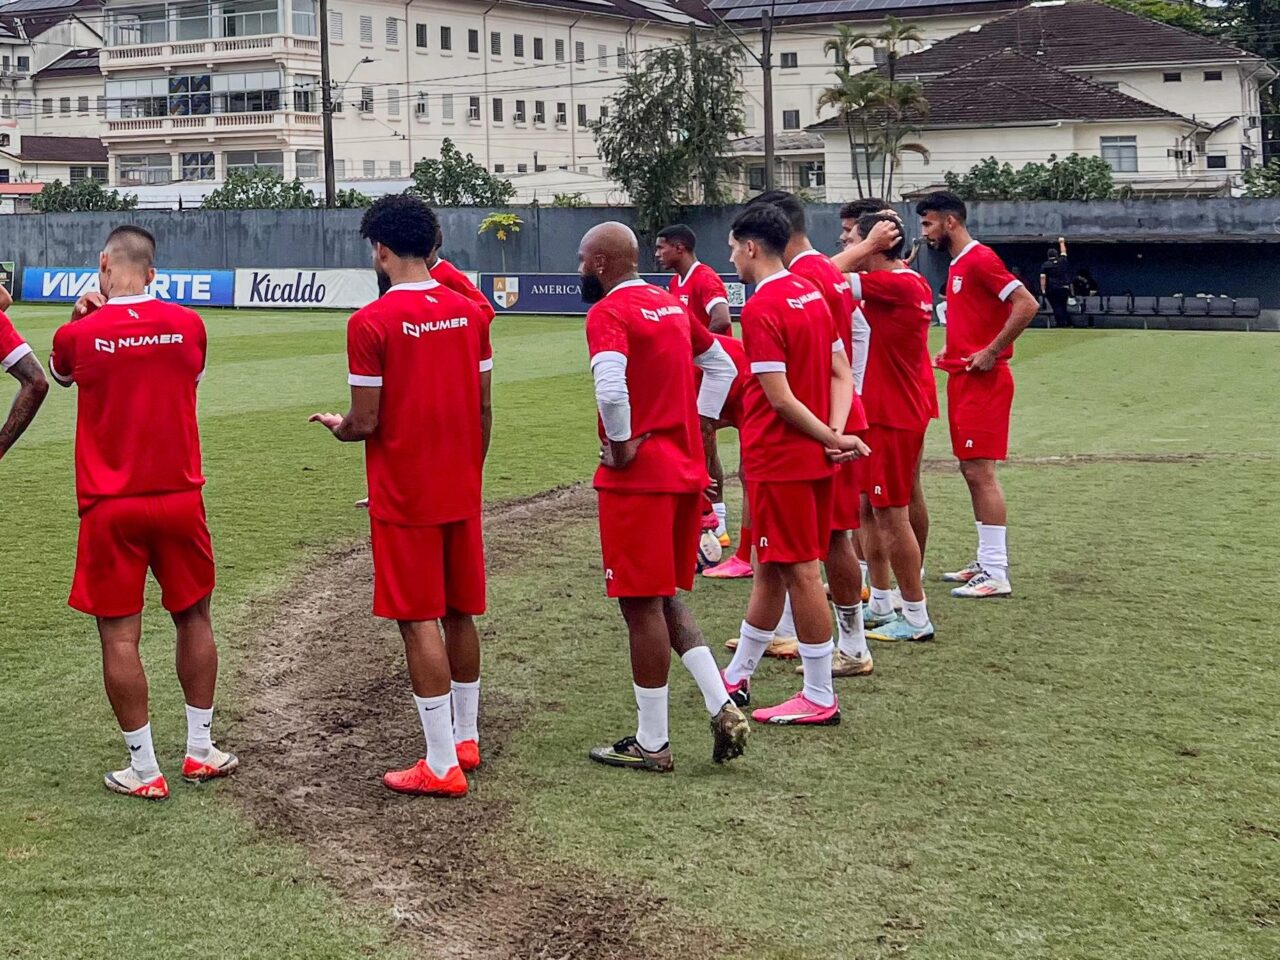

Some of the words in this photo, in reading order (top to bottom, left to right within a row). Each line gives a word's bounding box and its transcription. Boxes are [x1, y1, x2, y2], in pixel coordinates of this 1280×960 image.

[145, 274, 212, 300] RTE
[249, 272, 326, 303] Kicaldo
[420, 317, 468, 333] NUMER
[118, 333, 184, 348] NUMER
